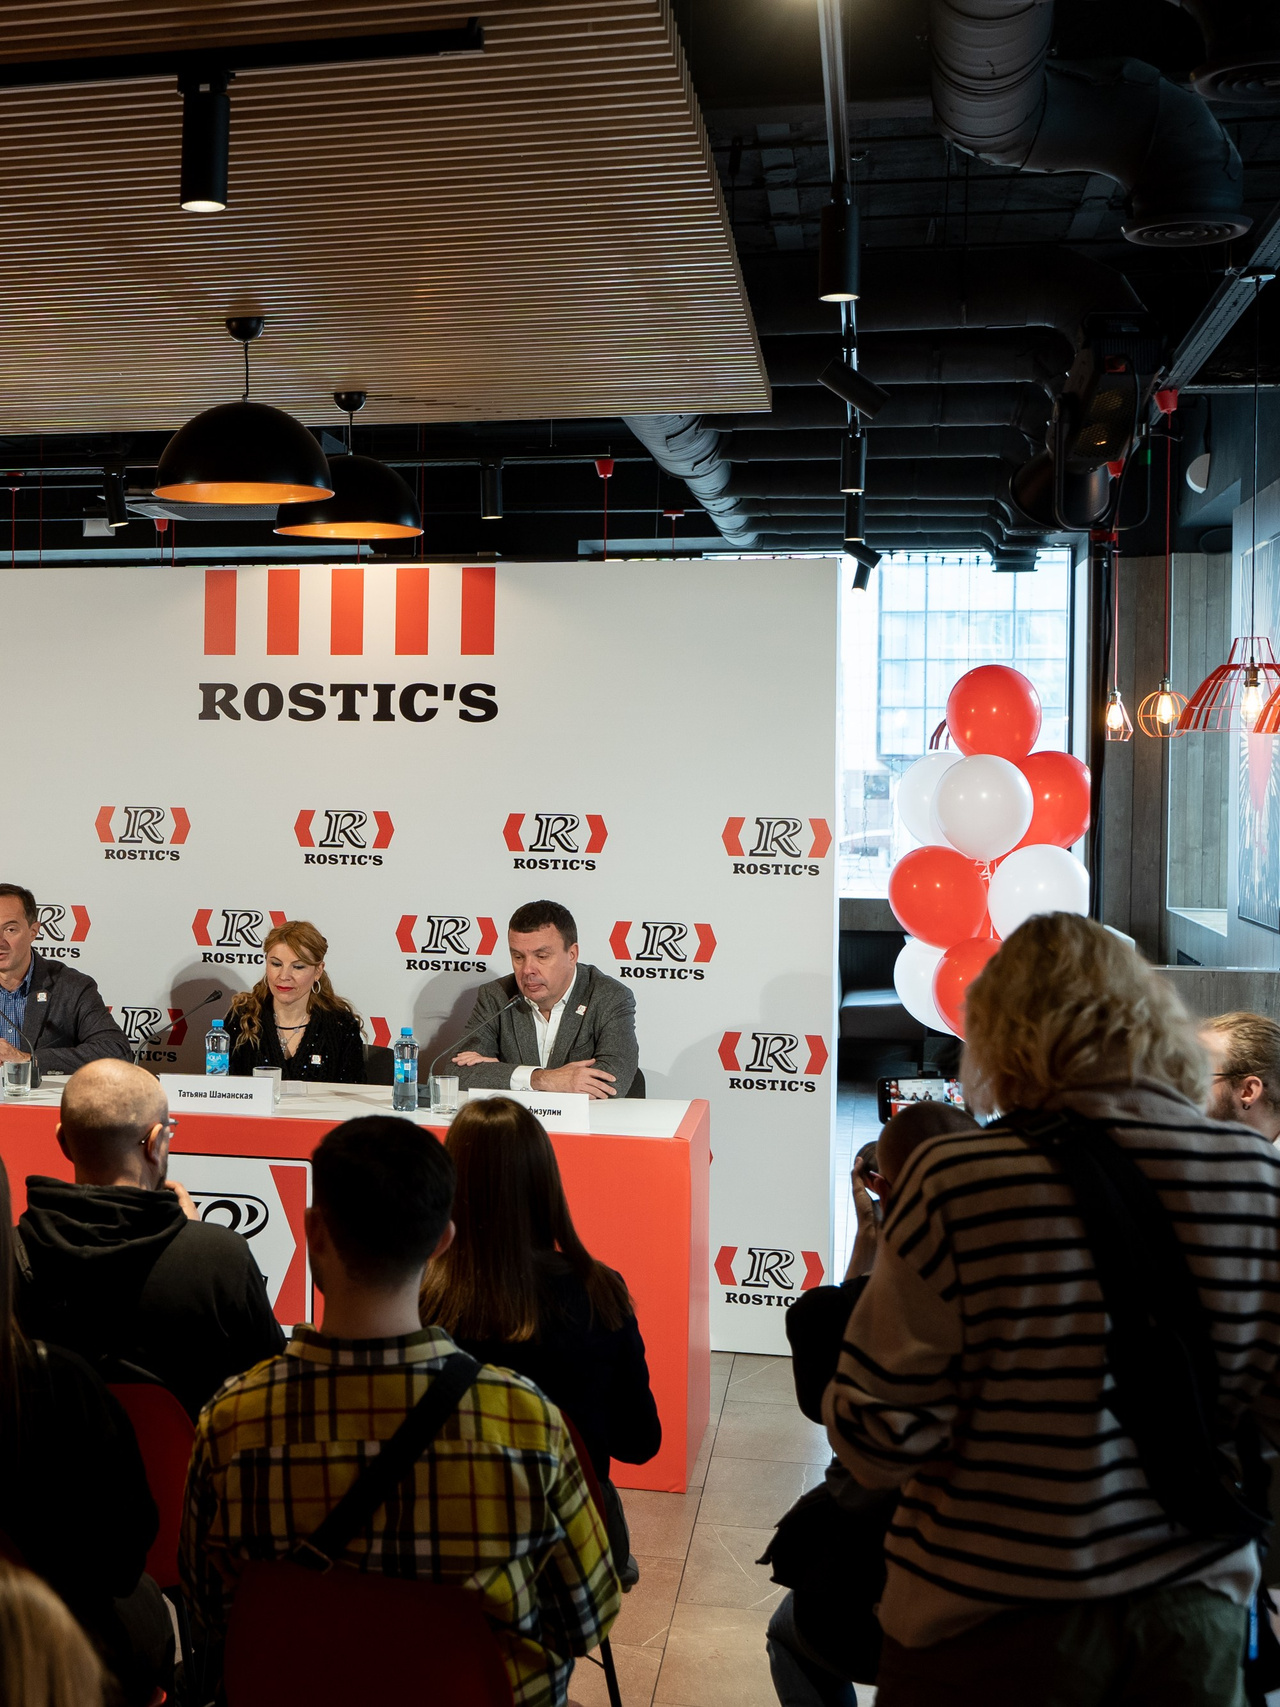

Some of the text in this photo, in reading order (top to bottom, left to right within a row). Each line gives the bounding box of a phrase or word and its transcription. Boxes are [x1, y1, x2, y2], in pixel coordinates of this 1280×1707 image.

[198, 682, 499, 723] ROSTIC'S
[119, 806, 165, 844] R
[319, 809, 368, 849] R
[528, 813, 580, 853] R
[748, 817, 803, 858] R
[104, 849, 180, 861] ROSTIC'S
[304, 853, 383, 866] ROSTIC'S
[513, 858, 596, 871] ROSTIC'S
[732, 863, 820, 876] ROSTIC'S
[216, 909, 264, 949] R
[420, 915, 471, 956] R
[635, 921, 688, 963] R
[31, 947, 81, 959] TIC'S
[405, 959, 487, 973] ROSTIC'S
[619, 966, 705, 981] ROSTIC'S
[744, 1032, 799, 1075] R
[178, 1089, 253, 1100] Татьяна Шаманская
[728, 1077, 816, 1093] ROSTIC'S
[741, 1247, 795, 1290] R
